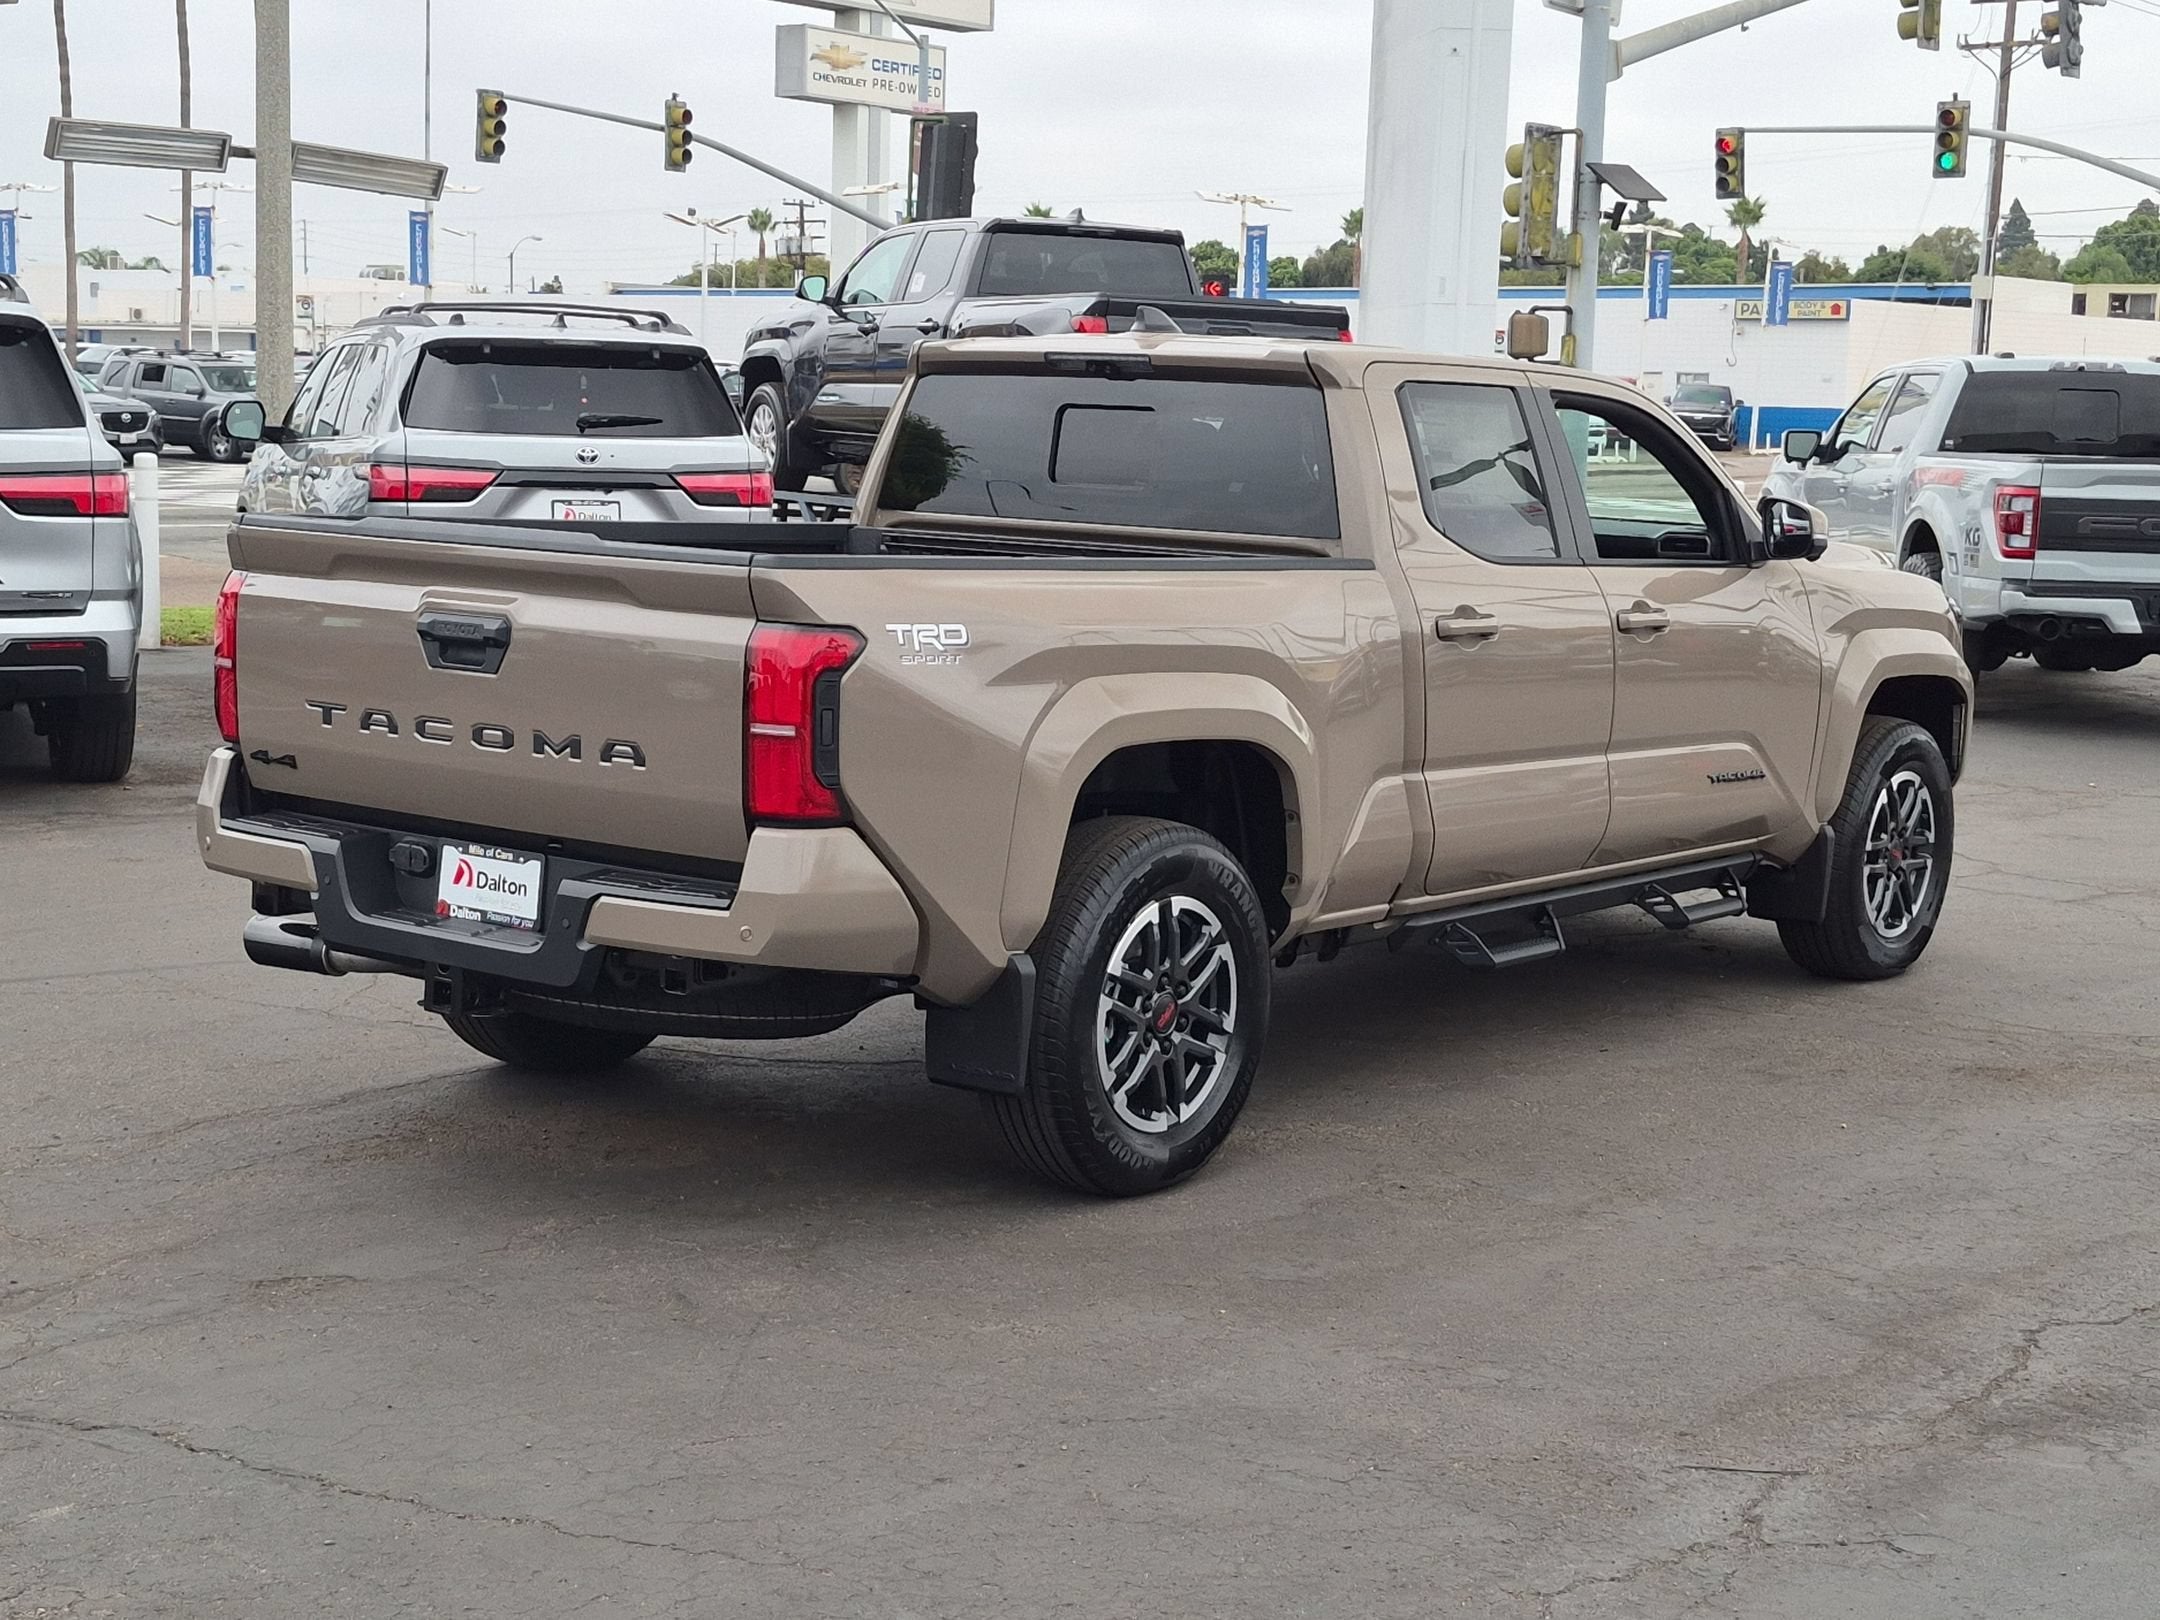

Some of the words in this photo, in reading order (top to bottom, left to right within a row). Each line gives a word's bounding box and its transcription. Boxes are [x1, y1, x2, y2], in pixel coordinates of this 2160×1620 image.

[871, 58, 942, 80] CERTIFED
[813, 71, 867, 88] CHEVROLET
[872, 78, 941, 98] PRE-OWED
[1794, 301, 1819, 309] BODY
[1797, 309, 1822, 317] PAINT
[1964, 527, 1981, 547] KG
[437, 622, 481, 639] TOYOTA
[885, 623, 970, 652] TRD
[900, 654, 963, 665] SPORT
[305, 699, 647, 770] TACOMA
[468, 844, 485, 856] Mile
[495, 849, 514, 861] Cars
[476, 871, 528, 897] Dalton
[449, 904, 481, 921] Dalton
